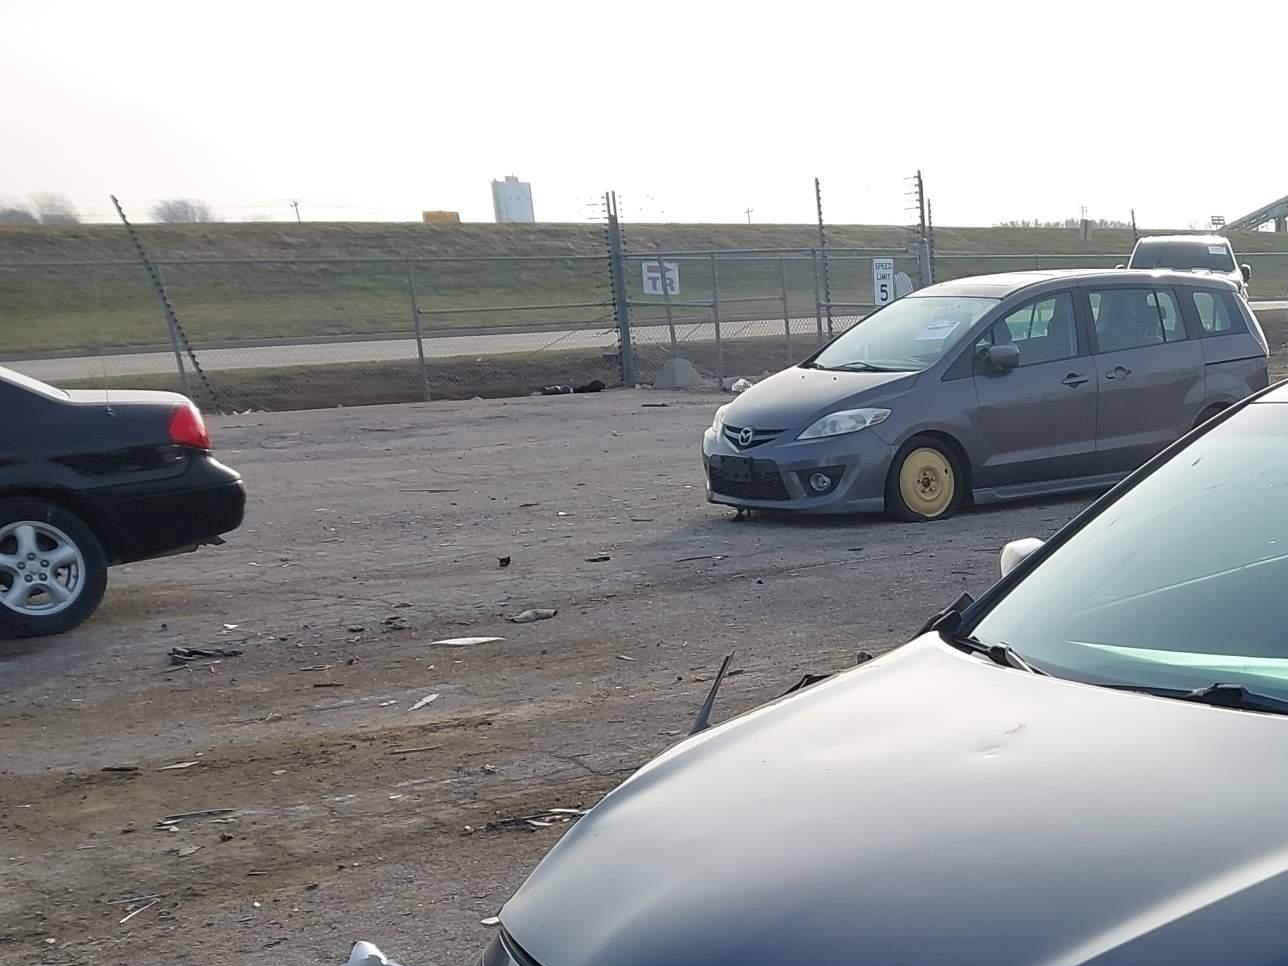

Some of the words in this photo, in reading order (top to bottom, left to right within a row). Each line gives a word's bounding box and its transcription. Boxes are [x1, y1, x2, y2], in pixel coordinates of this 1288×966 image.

[874, 262, 892, 270] SPEED
[876, 272, 890, 281] LIMIT
[880, 283, 889, 302] 5
